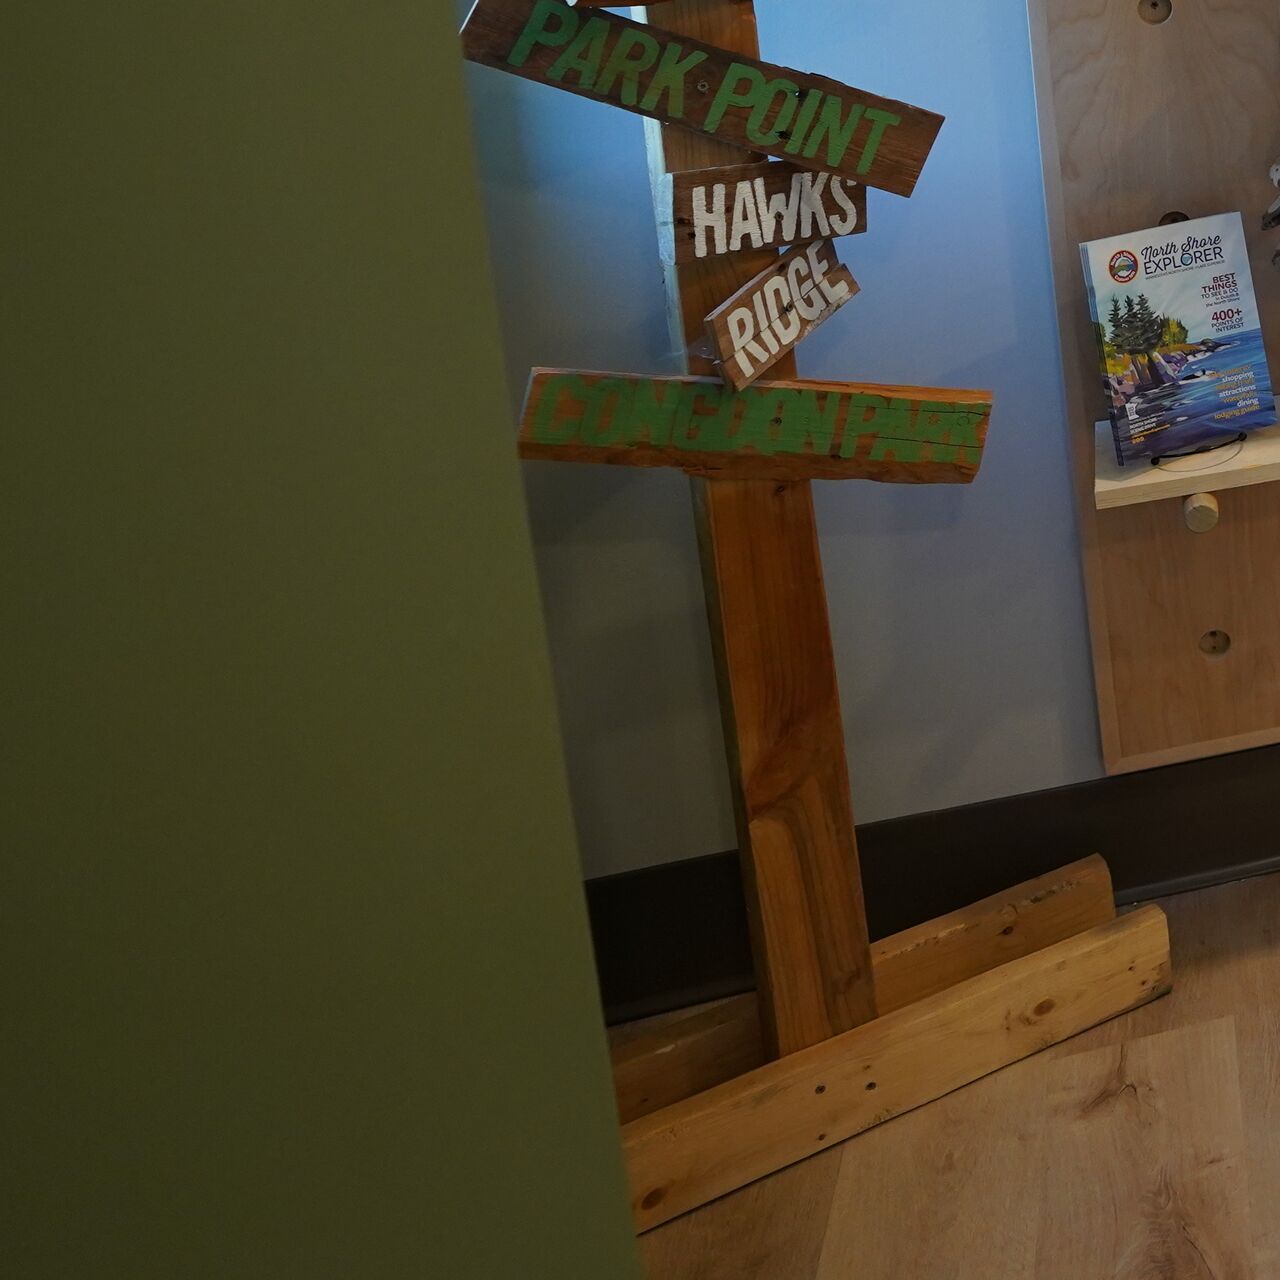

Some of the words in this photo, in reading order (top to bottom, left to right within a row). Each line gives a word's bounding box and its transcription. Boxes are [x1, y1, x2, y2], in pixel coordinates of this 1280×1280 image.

[704, 62, 901, 176] POINT
[691, 172, 859, 258] HAWKS
[1141, 242, 1179, 262] North
[1181, 235, 1222, 253] Shore
[1144, 246, 1224, 275] EXPLORER
[1212, 272, 1236, 284] BEST
[1202, 280, 1238, 294] THINGS
[1210, 290, 1222, 298] SEE
[727, 240, 850, 377] RIDGE
[1212, 308, 1243, 322] 400+
[1211, 320, 1235, 329] POINTS
[1216, 323, 1244, 332] INTEREST
[1222, 371, 1255, 383] shopping
[1219, 384, 1256, 398] attractions
[1237, 397, 1260, 408] dining
[533, 374, 840, 457] CONGDON
[840, 393, 989, 464] PARK
[1214, 410, 1240, 420] lodging
[1240, 404, 1260, 416] guide
